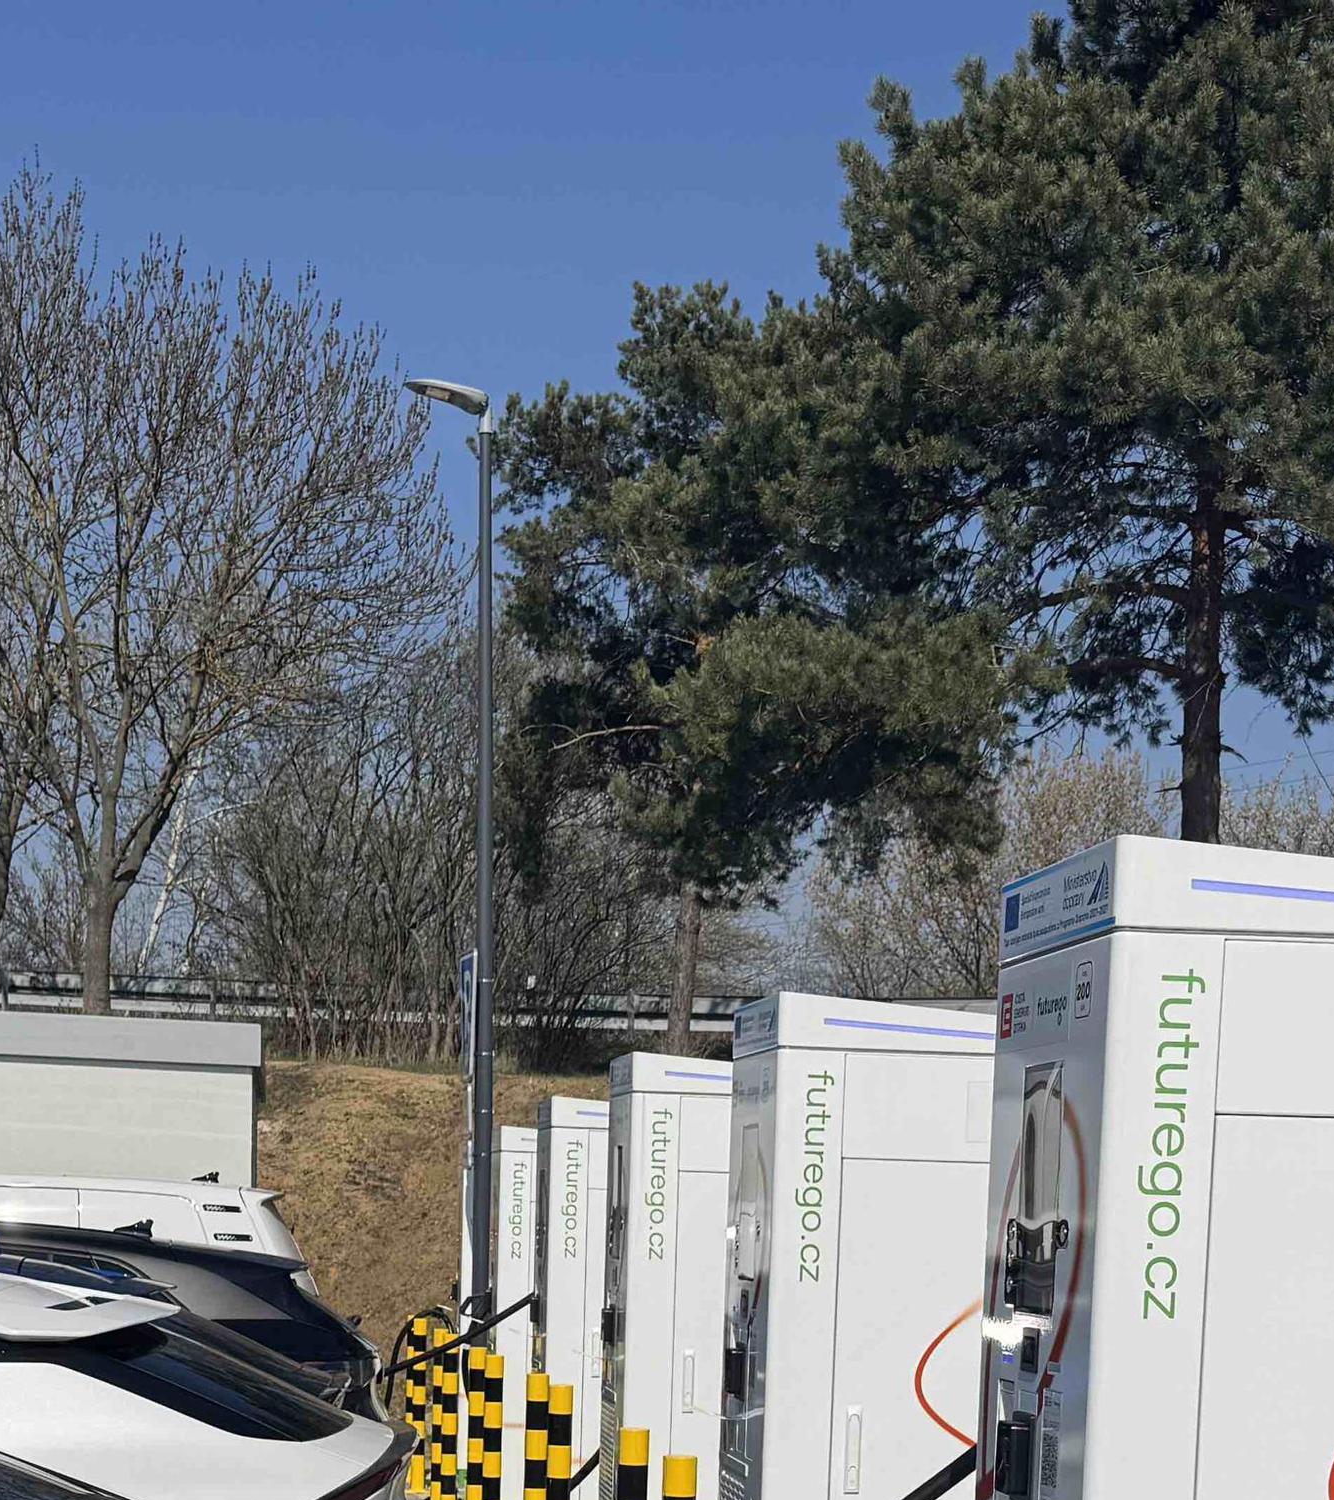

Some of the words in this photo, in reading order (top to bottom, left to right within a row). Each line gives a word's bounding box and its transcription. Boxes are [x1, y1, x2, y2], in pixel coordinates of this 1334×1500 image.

[1038, 996, 1067, 1026] futurego
[1076, 981, 1091, 1001] 200
[561, 1139, 583, 1259] futurego.cz
[644, 1108, 673, 1261] futurego.cz
[795, 1070, 835, 1283] futurego.cz
[1138, 968, 1206, 1320] futurego.cz
[508, 1161, 528, 1260] futurego.cz
